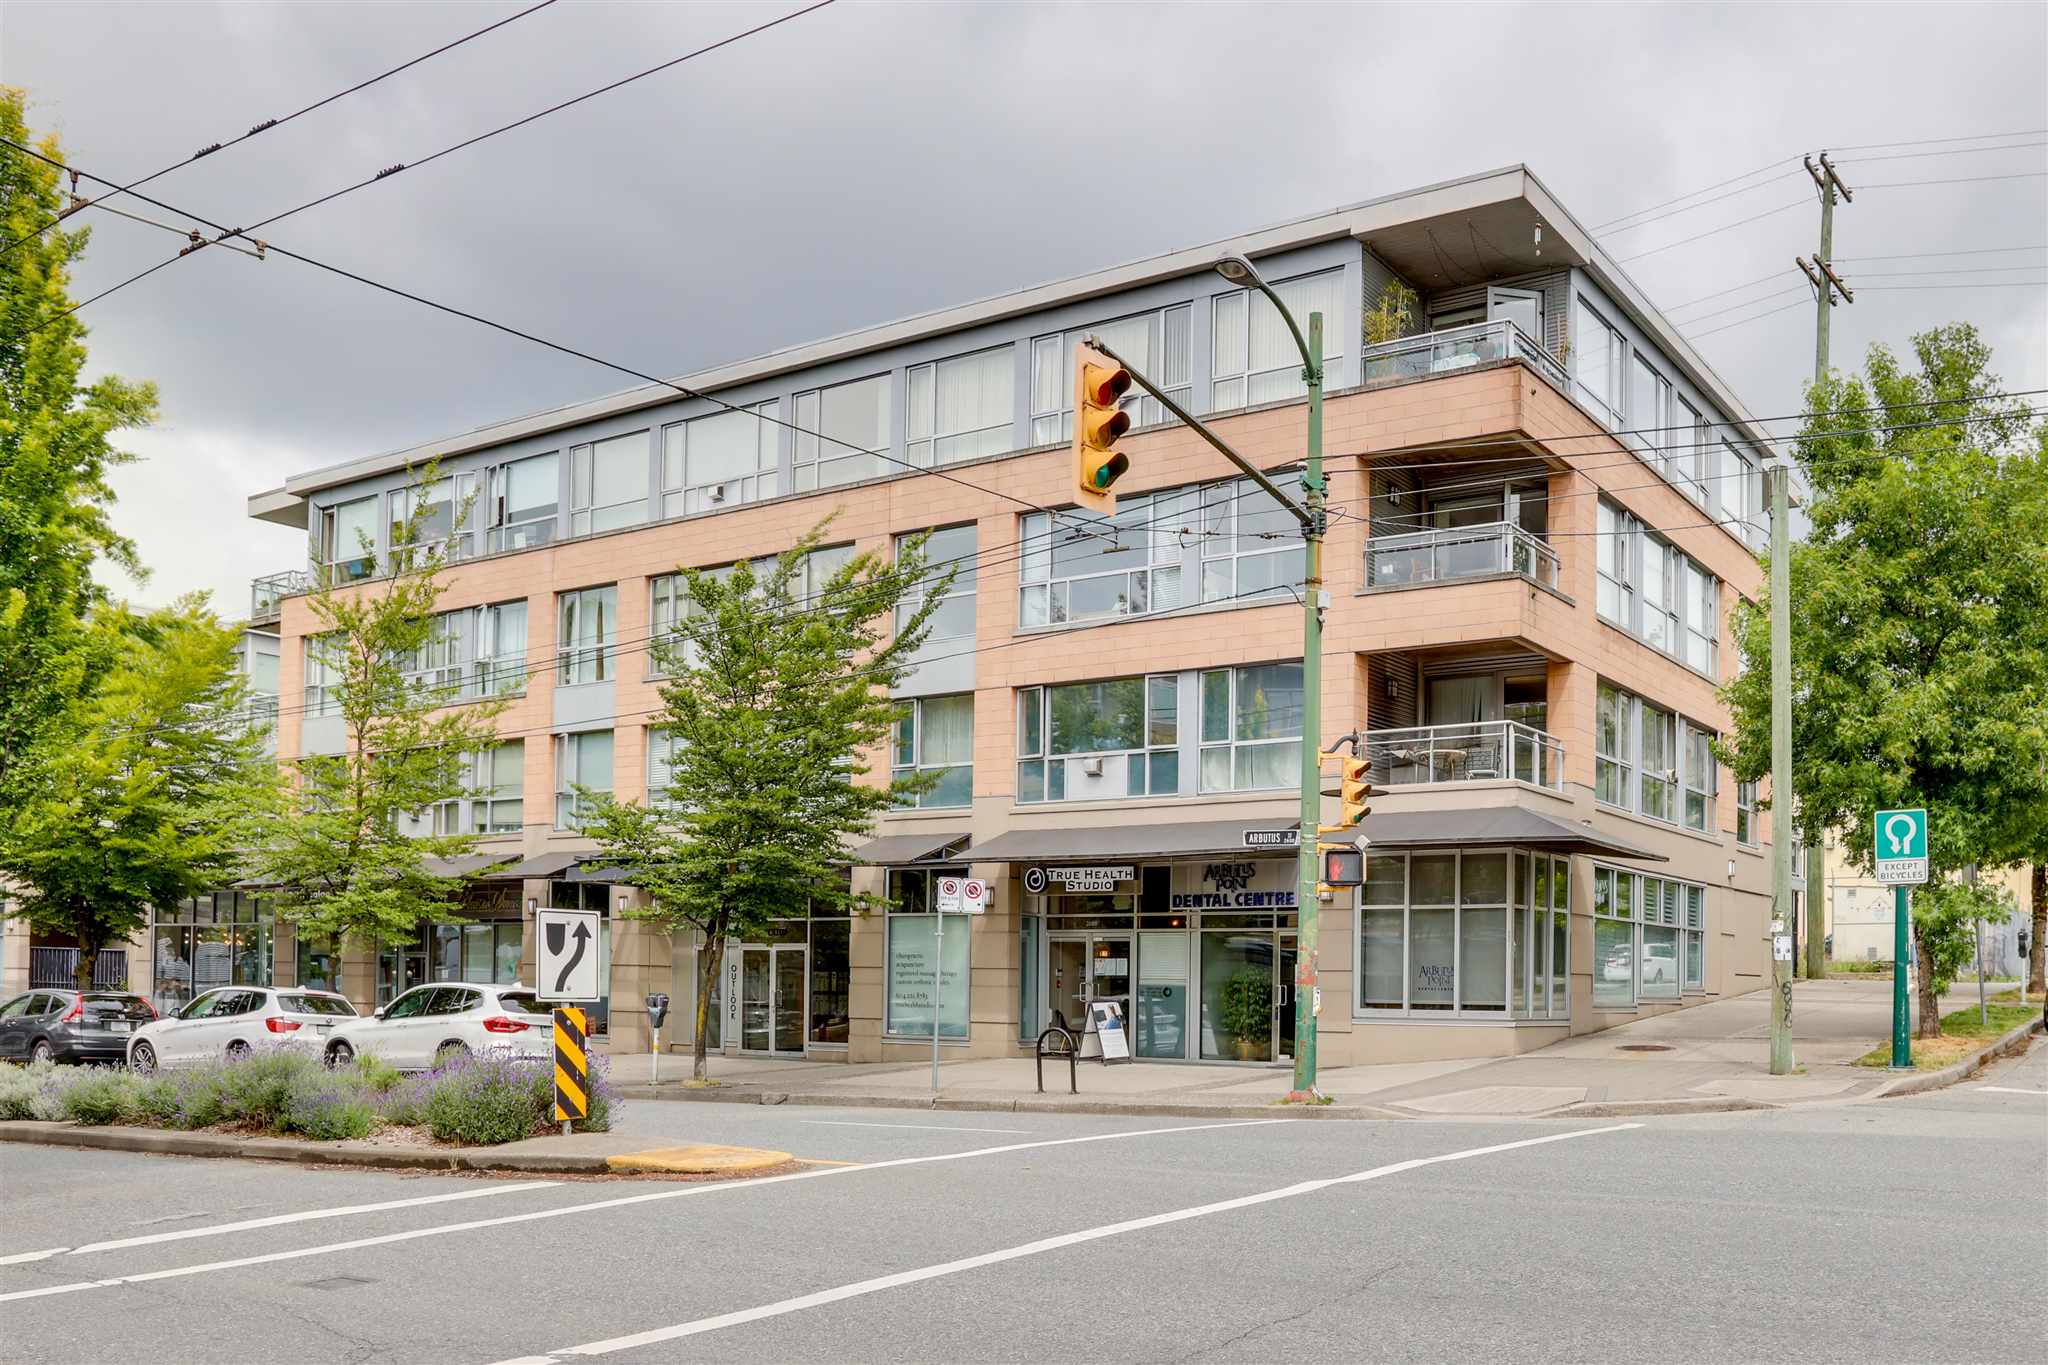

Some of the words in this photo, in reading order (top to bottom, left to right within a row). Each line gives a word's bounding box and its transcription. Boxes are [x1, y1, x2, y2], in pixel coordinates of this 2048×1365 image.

[1249, 833, 1280, 843] ARBUTUS
[1885, 862, 1918, 870] EXCEPT
[1049, 870, 1080, 880] TRUE
[1085, 869, 1133, 880] HEALTH
[1880, 871, 1924, 880] BICYCLES
[1067, 880, 1112, 890] STUDIO
[1172, 893, 1231, 908] DENTAL
[1234, 892, 1295, 907] CENTRE
